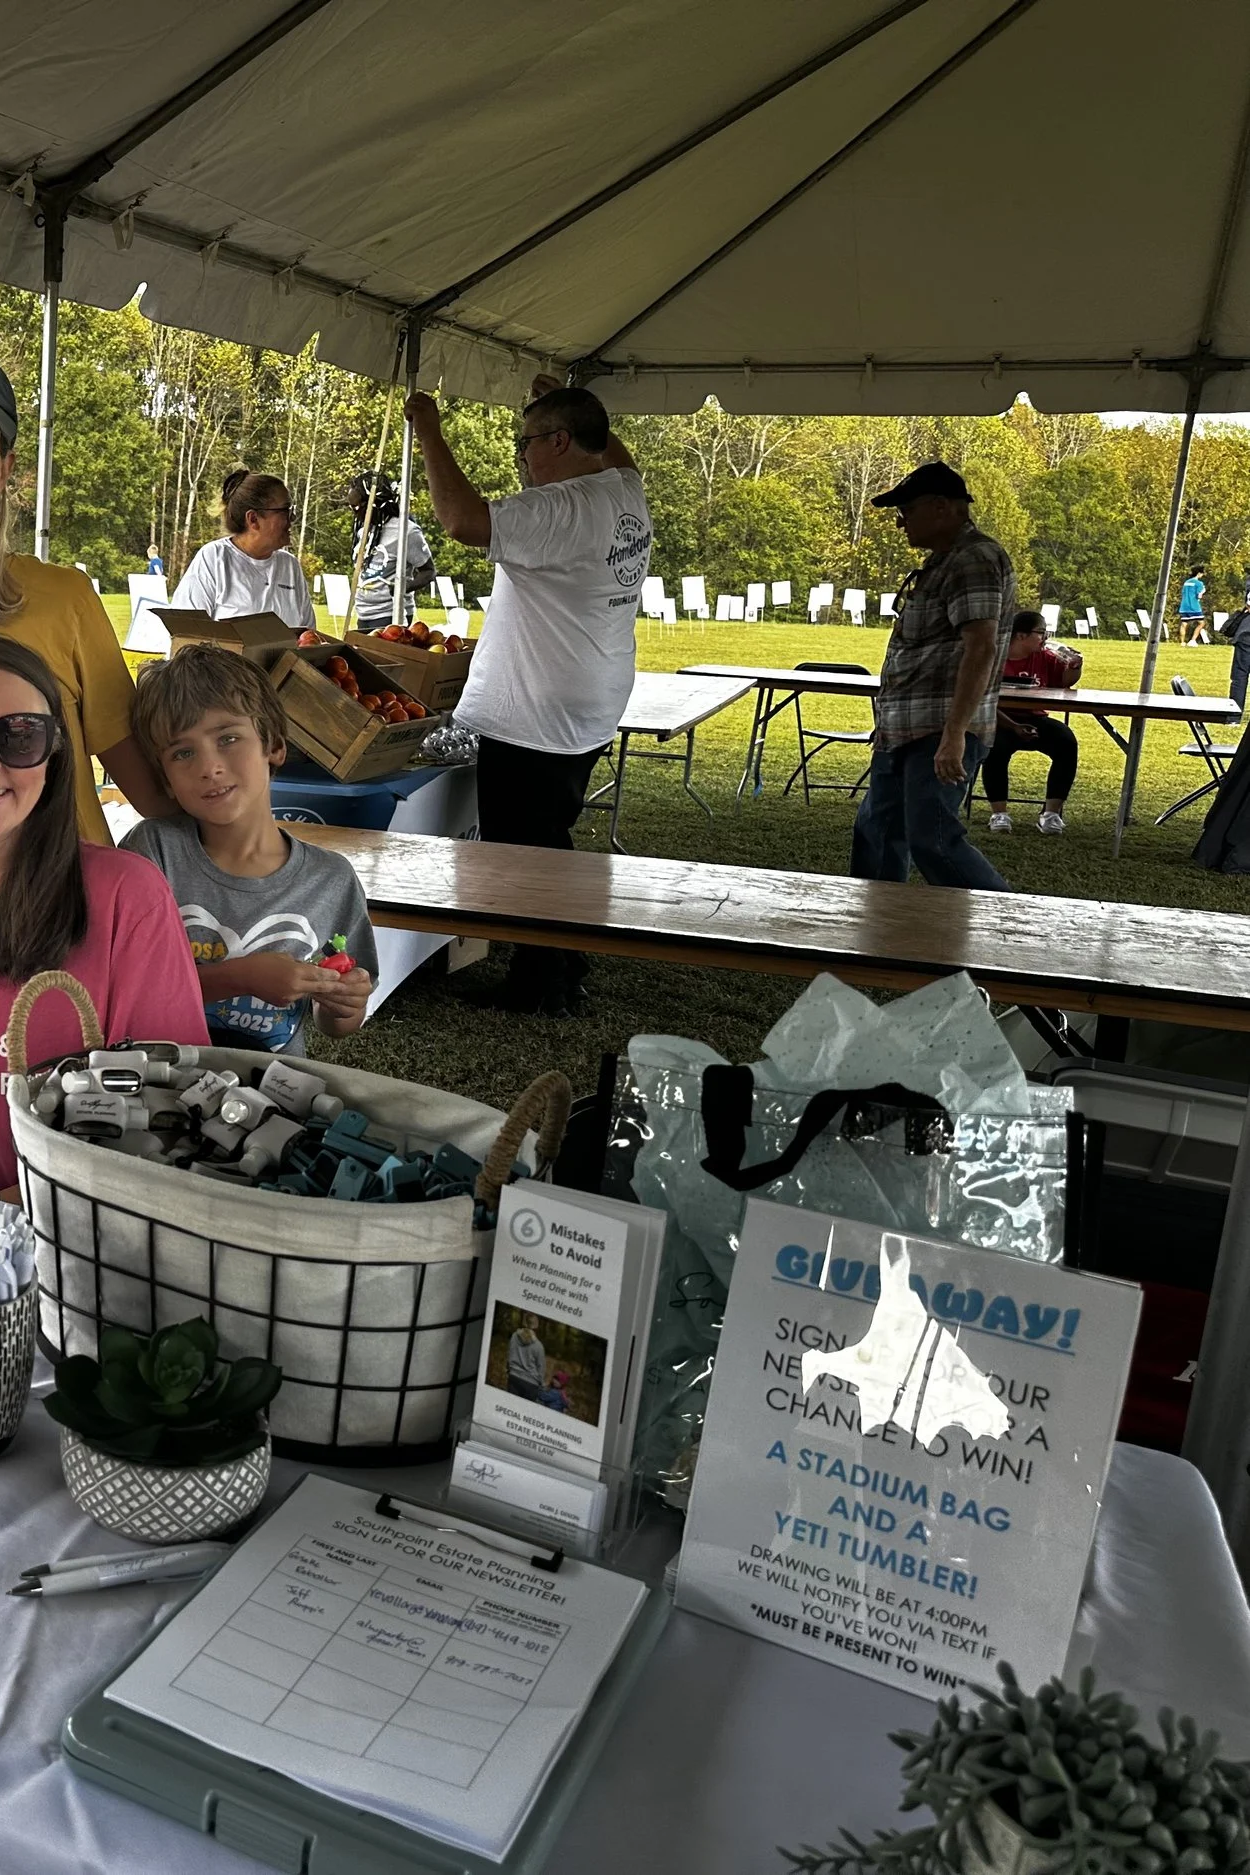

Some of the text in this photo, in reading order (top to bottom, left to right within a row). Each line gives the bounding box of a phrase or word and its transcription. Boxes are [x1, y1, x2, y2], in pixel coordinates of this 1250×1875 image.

[228, 1010, 274, 1033] 2025
[520, 1218, 535, 1238] 6
[550, 1222, 606, 1251] Mistakes
[549, 1241, 603, 1269] to Avoid
[511, 1254, 601, 1292] When Planning for a
[520, 1272, 589, 1303] Loved One with
[521, 1288, 583, 1317] Special Needs
[775, 1317, 847, 1350] SIGN
[495, 1404, 583, 1444] SPECIAL NEEDS PLANNING
[506, 1420, 568, 1450] ESTATE PLANNING
[1024, 1425, 1050, 1451] A
[516, 1436, 555, 1457] ELDER LAW
[961, 1441, 1034, 1485] WIN!
[766, 1440, 1011, 1532] A STADIUM BAG
[828, 1496, 928, 1545] AND A
[312, 1539, 379, 1567] FIRST AND LAST
[325, 1552, 354, 1566] NAME
[332, 1520, 567, 1606] SIGN UP FOR OUR NEWSLETTER!
[353, 1515, 556, 1591] Southpoint Estate Planning
[775, 1510, 979, 1600] YETI TUMBLER!
[415, 1577, 445, 1591] EMAIL
[751, 1543, 988, 1639] DRAWING WILL BE AT 4:00PM
[483, 1600, 518, 1616] PHONE
[518, 1611, 561, 1630] NUMBER
[737, 1558, 998, 1660] WE WILL NOTIFY YOU VIA TEXT IF
[801, 1600, 918, 1655] YOU'VE WON!
[802, 1621, 822, 1640] BE
[825, 1630, 892, 1665] PRESENT
[895, 1655, 918, 1674] TO
